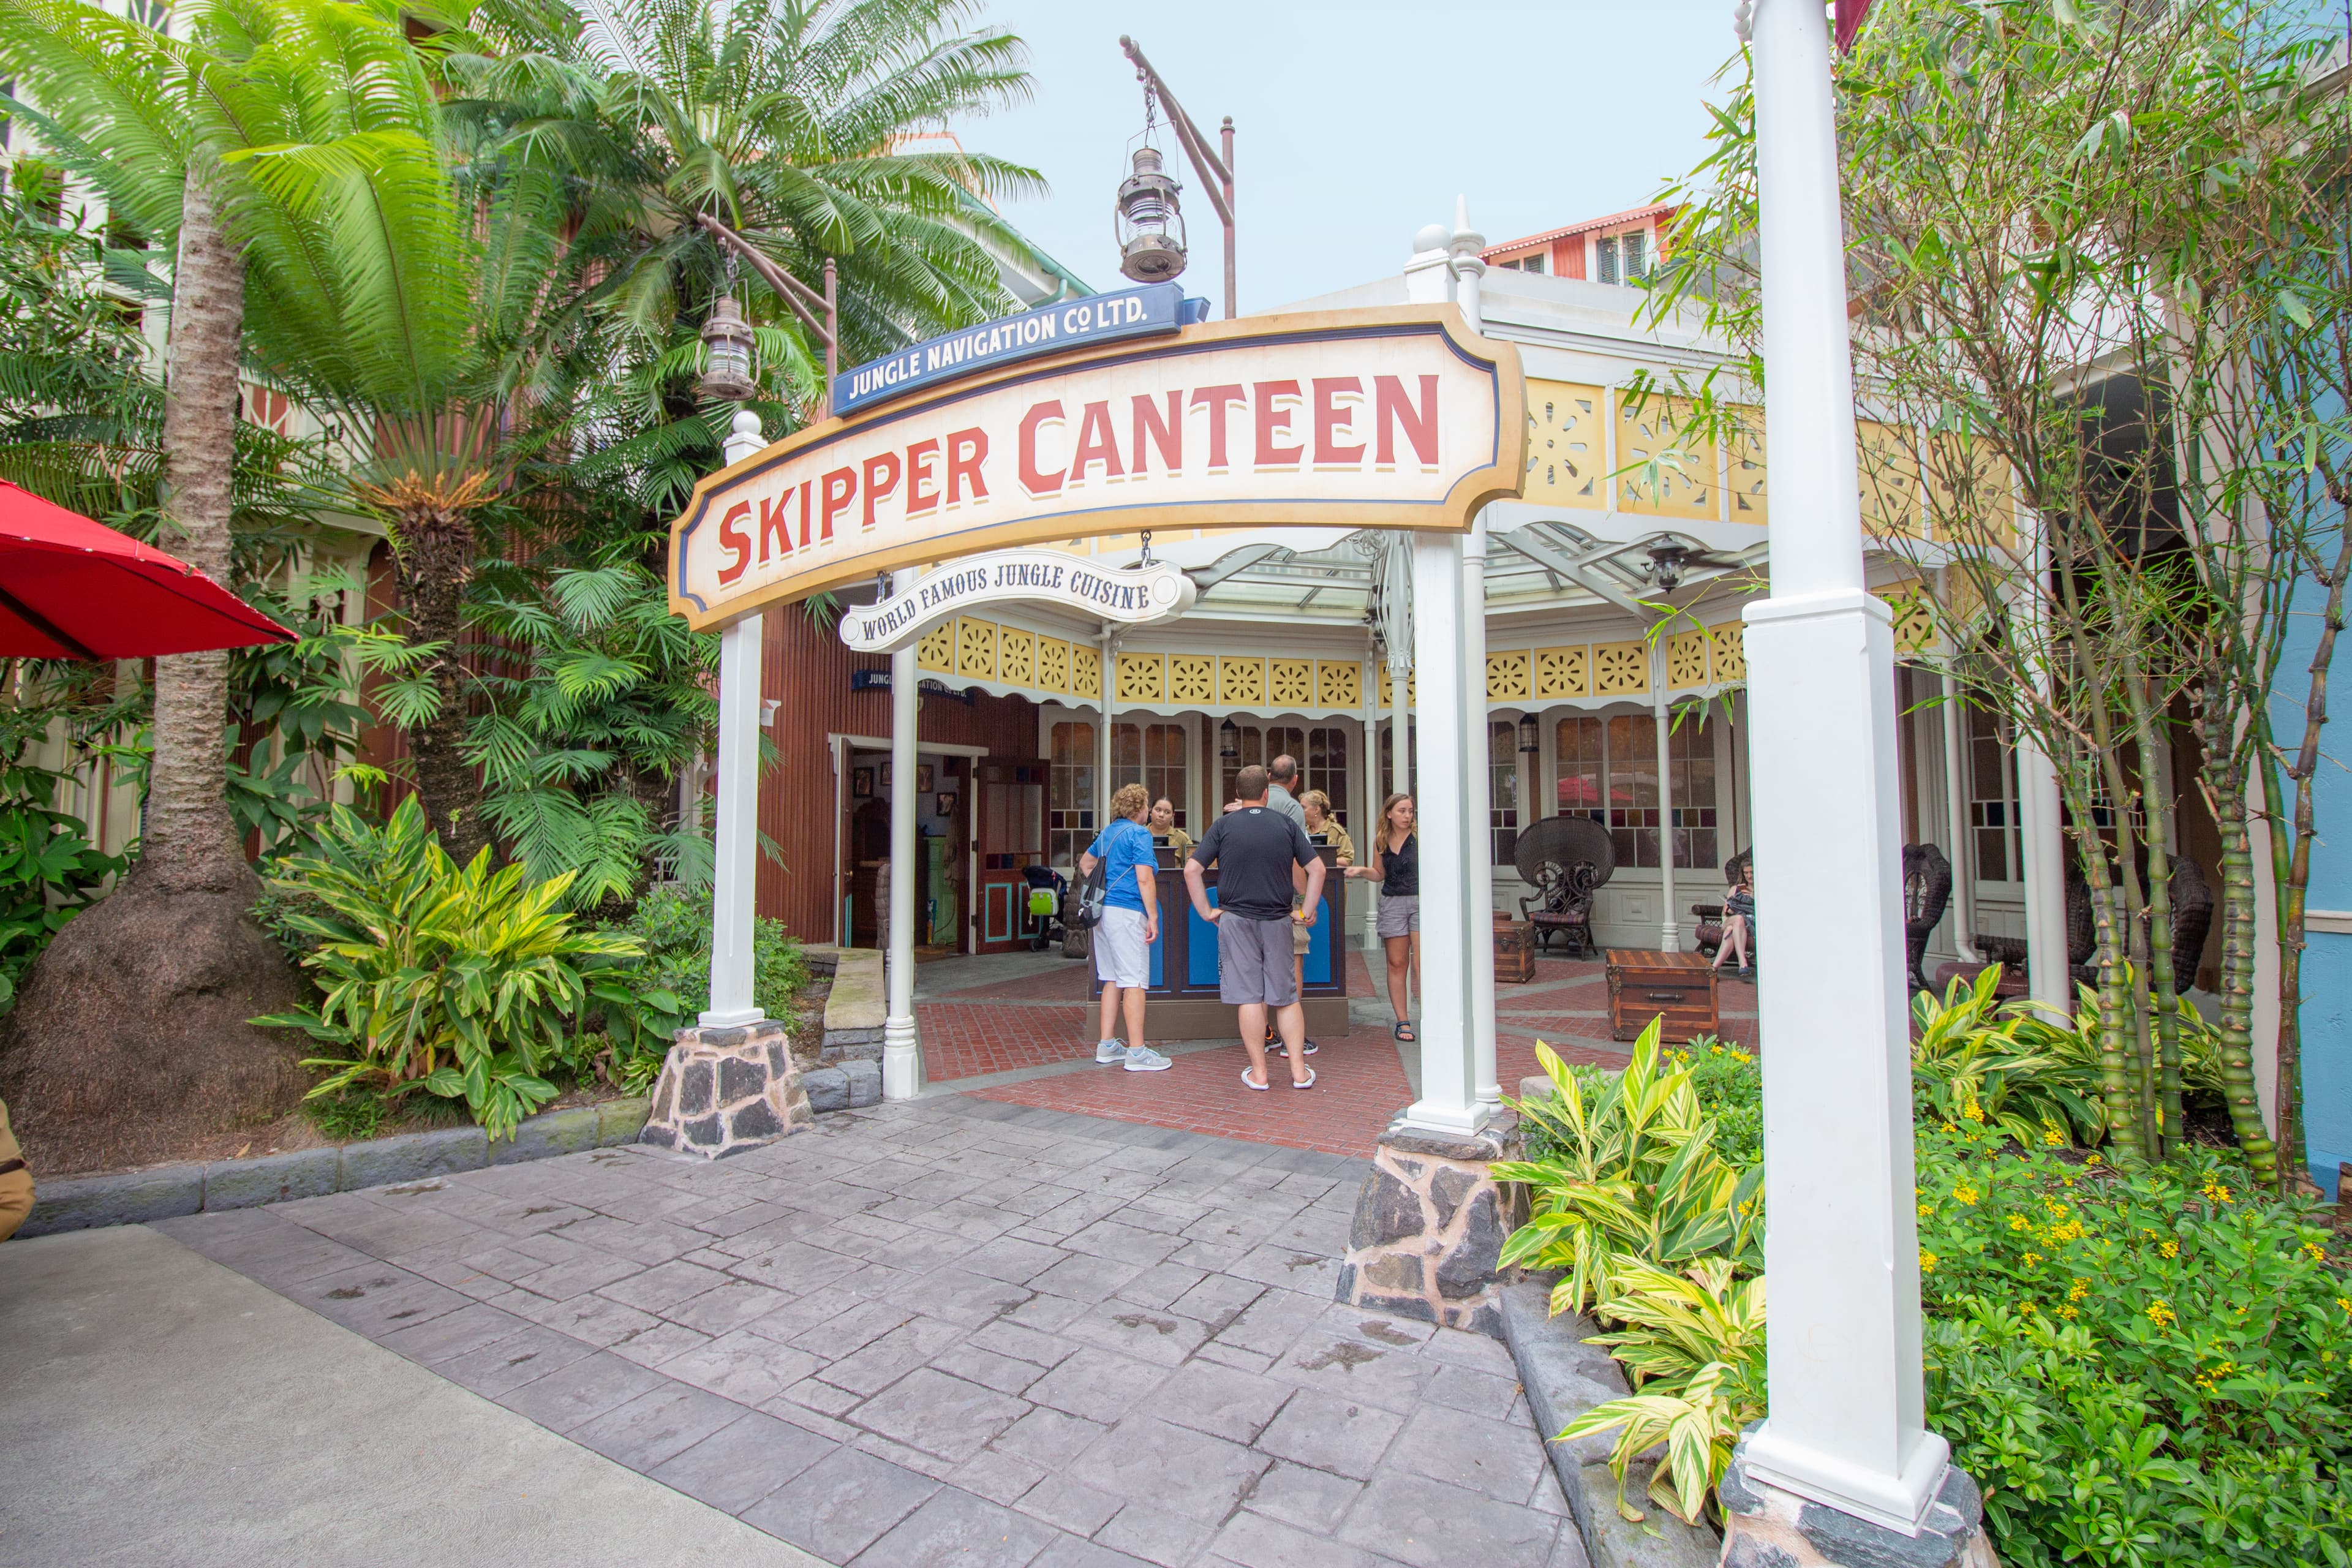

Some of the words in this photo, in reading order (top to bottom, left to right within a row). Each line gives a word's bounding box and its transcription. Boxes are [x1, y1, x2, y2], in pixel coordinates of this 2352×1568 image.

[849, 353, 921, 400] JUNGLE
[927, 313, 1056, 372] NAVIGATION
[1097, 296, 1148, 328] LTD.
[717, 426, 990, 590] SKIPPER
[1017, 374, 1440, 501] CANTEEN
[862, 598, 916, 641] WORLD
[919, 568, 987, 611] FAMOUS
[995, 564, 1064, 588] JUNGLE
[1071, 570, 1150, 609] CUISINE
[869, 674, 892, 685] JUNGL
